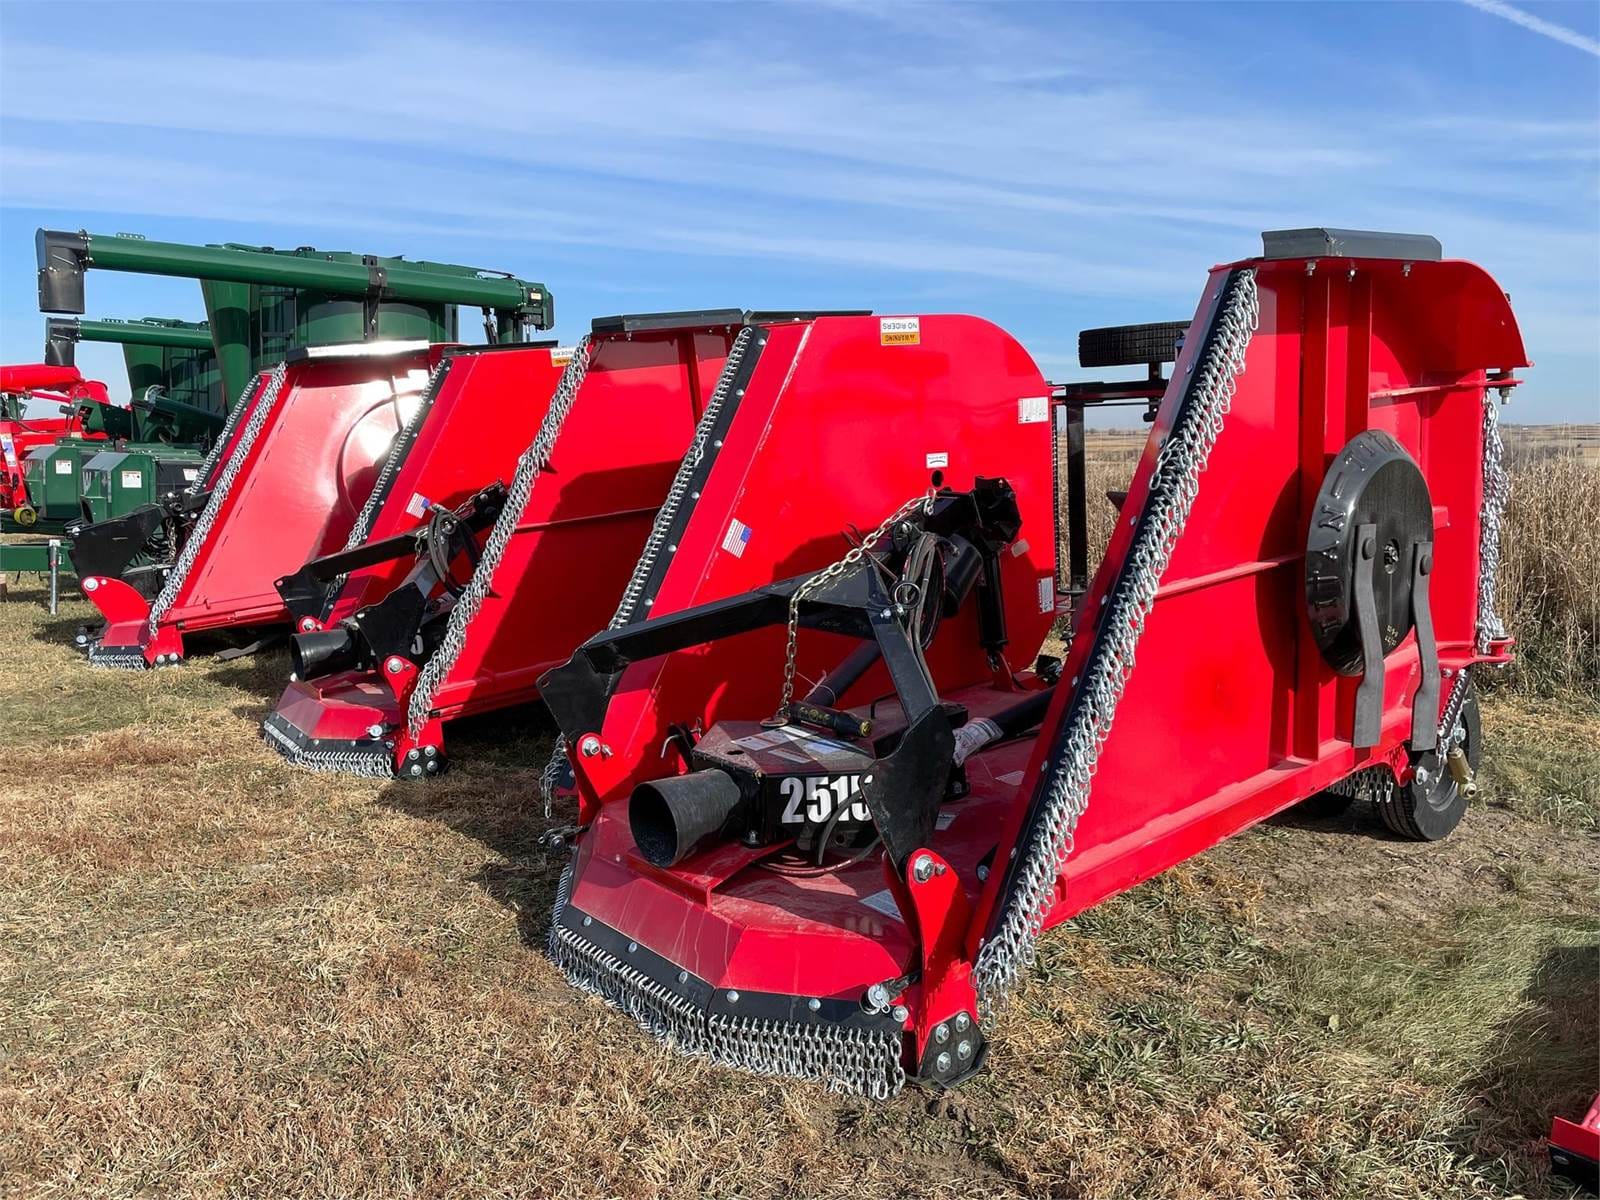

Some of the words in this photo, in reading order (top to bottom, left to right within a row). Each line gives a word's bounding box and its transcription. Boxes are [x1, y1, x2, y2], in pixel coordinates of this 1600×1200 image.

[883, 322, 907, 330] RIDERS
[908, 322, 918, 330] NO
[780, 775, 874, 823] 2515
